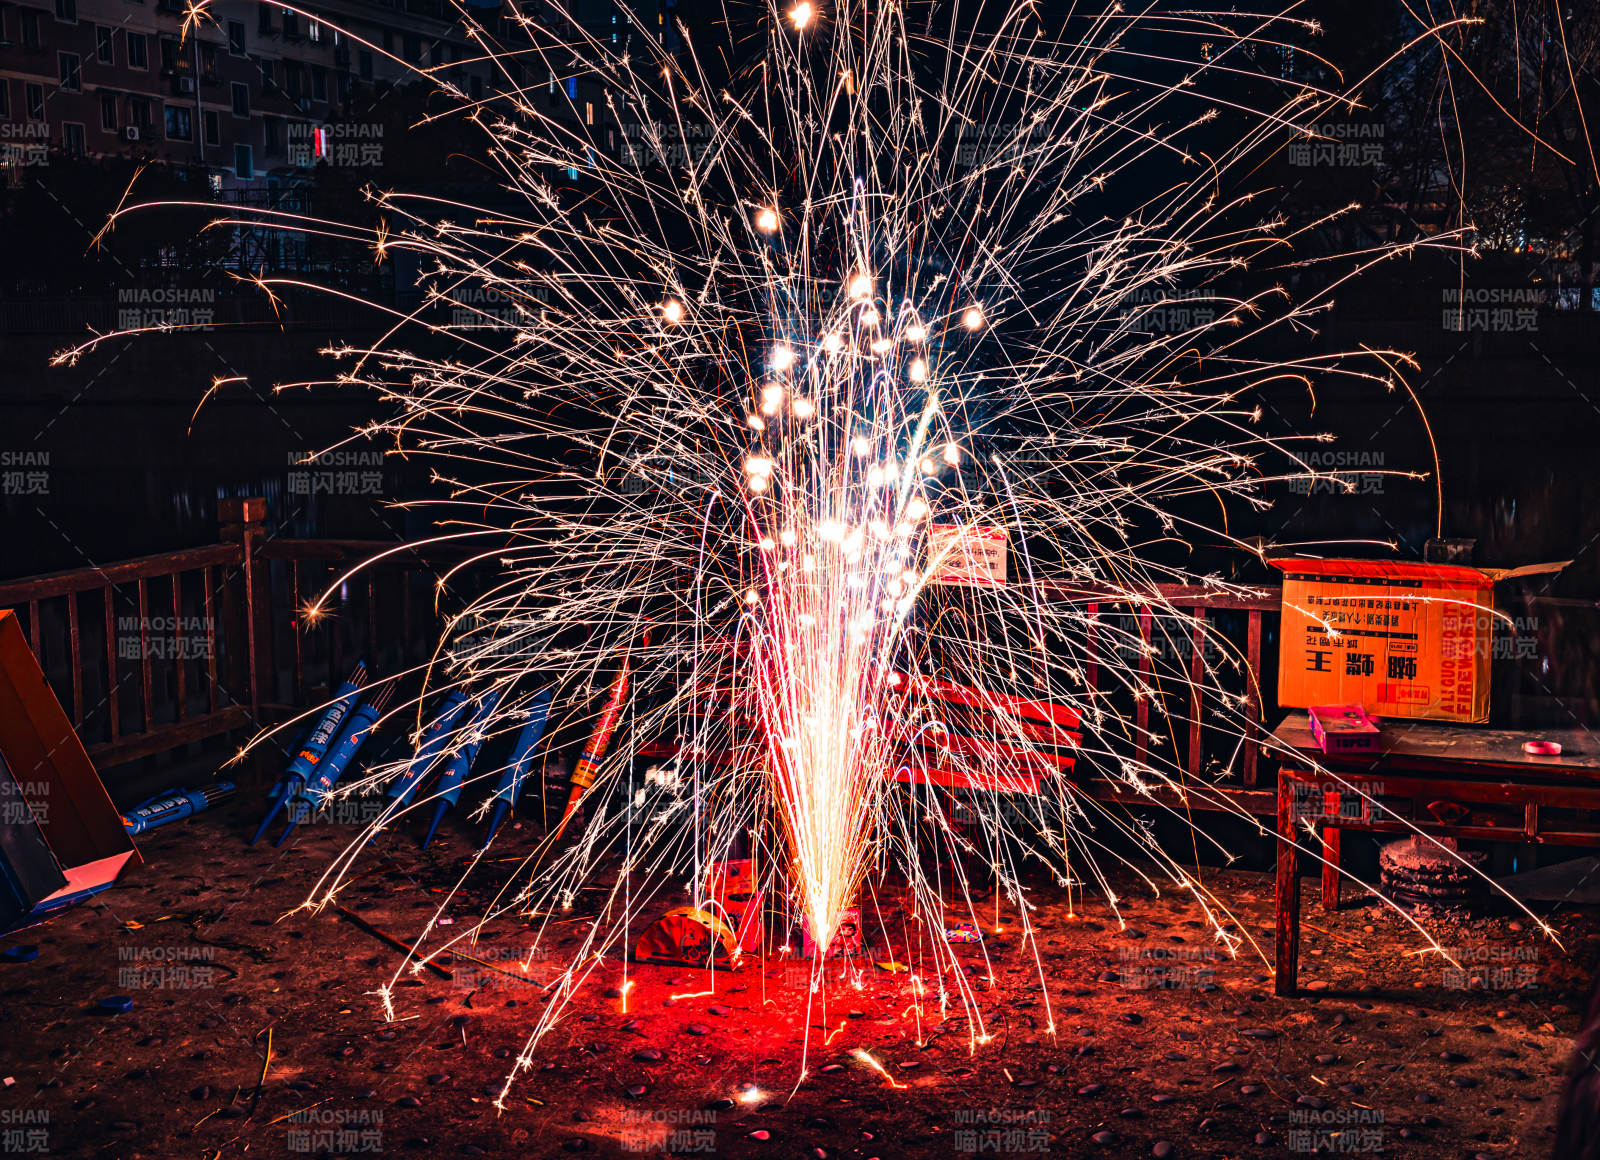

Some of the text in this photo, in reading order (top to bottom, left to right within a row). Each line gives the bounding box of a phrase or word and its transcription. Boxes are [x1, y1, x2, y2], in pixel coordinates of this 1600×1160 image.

[1305, 636, 1358, 649] 城市烟花
[1456, 598, 1474, 715] FIREWORKS
[1305, 650, 1417, 681] 蝴蝶王
[1440, 660, 1456, 687] GUO
